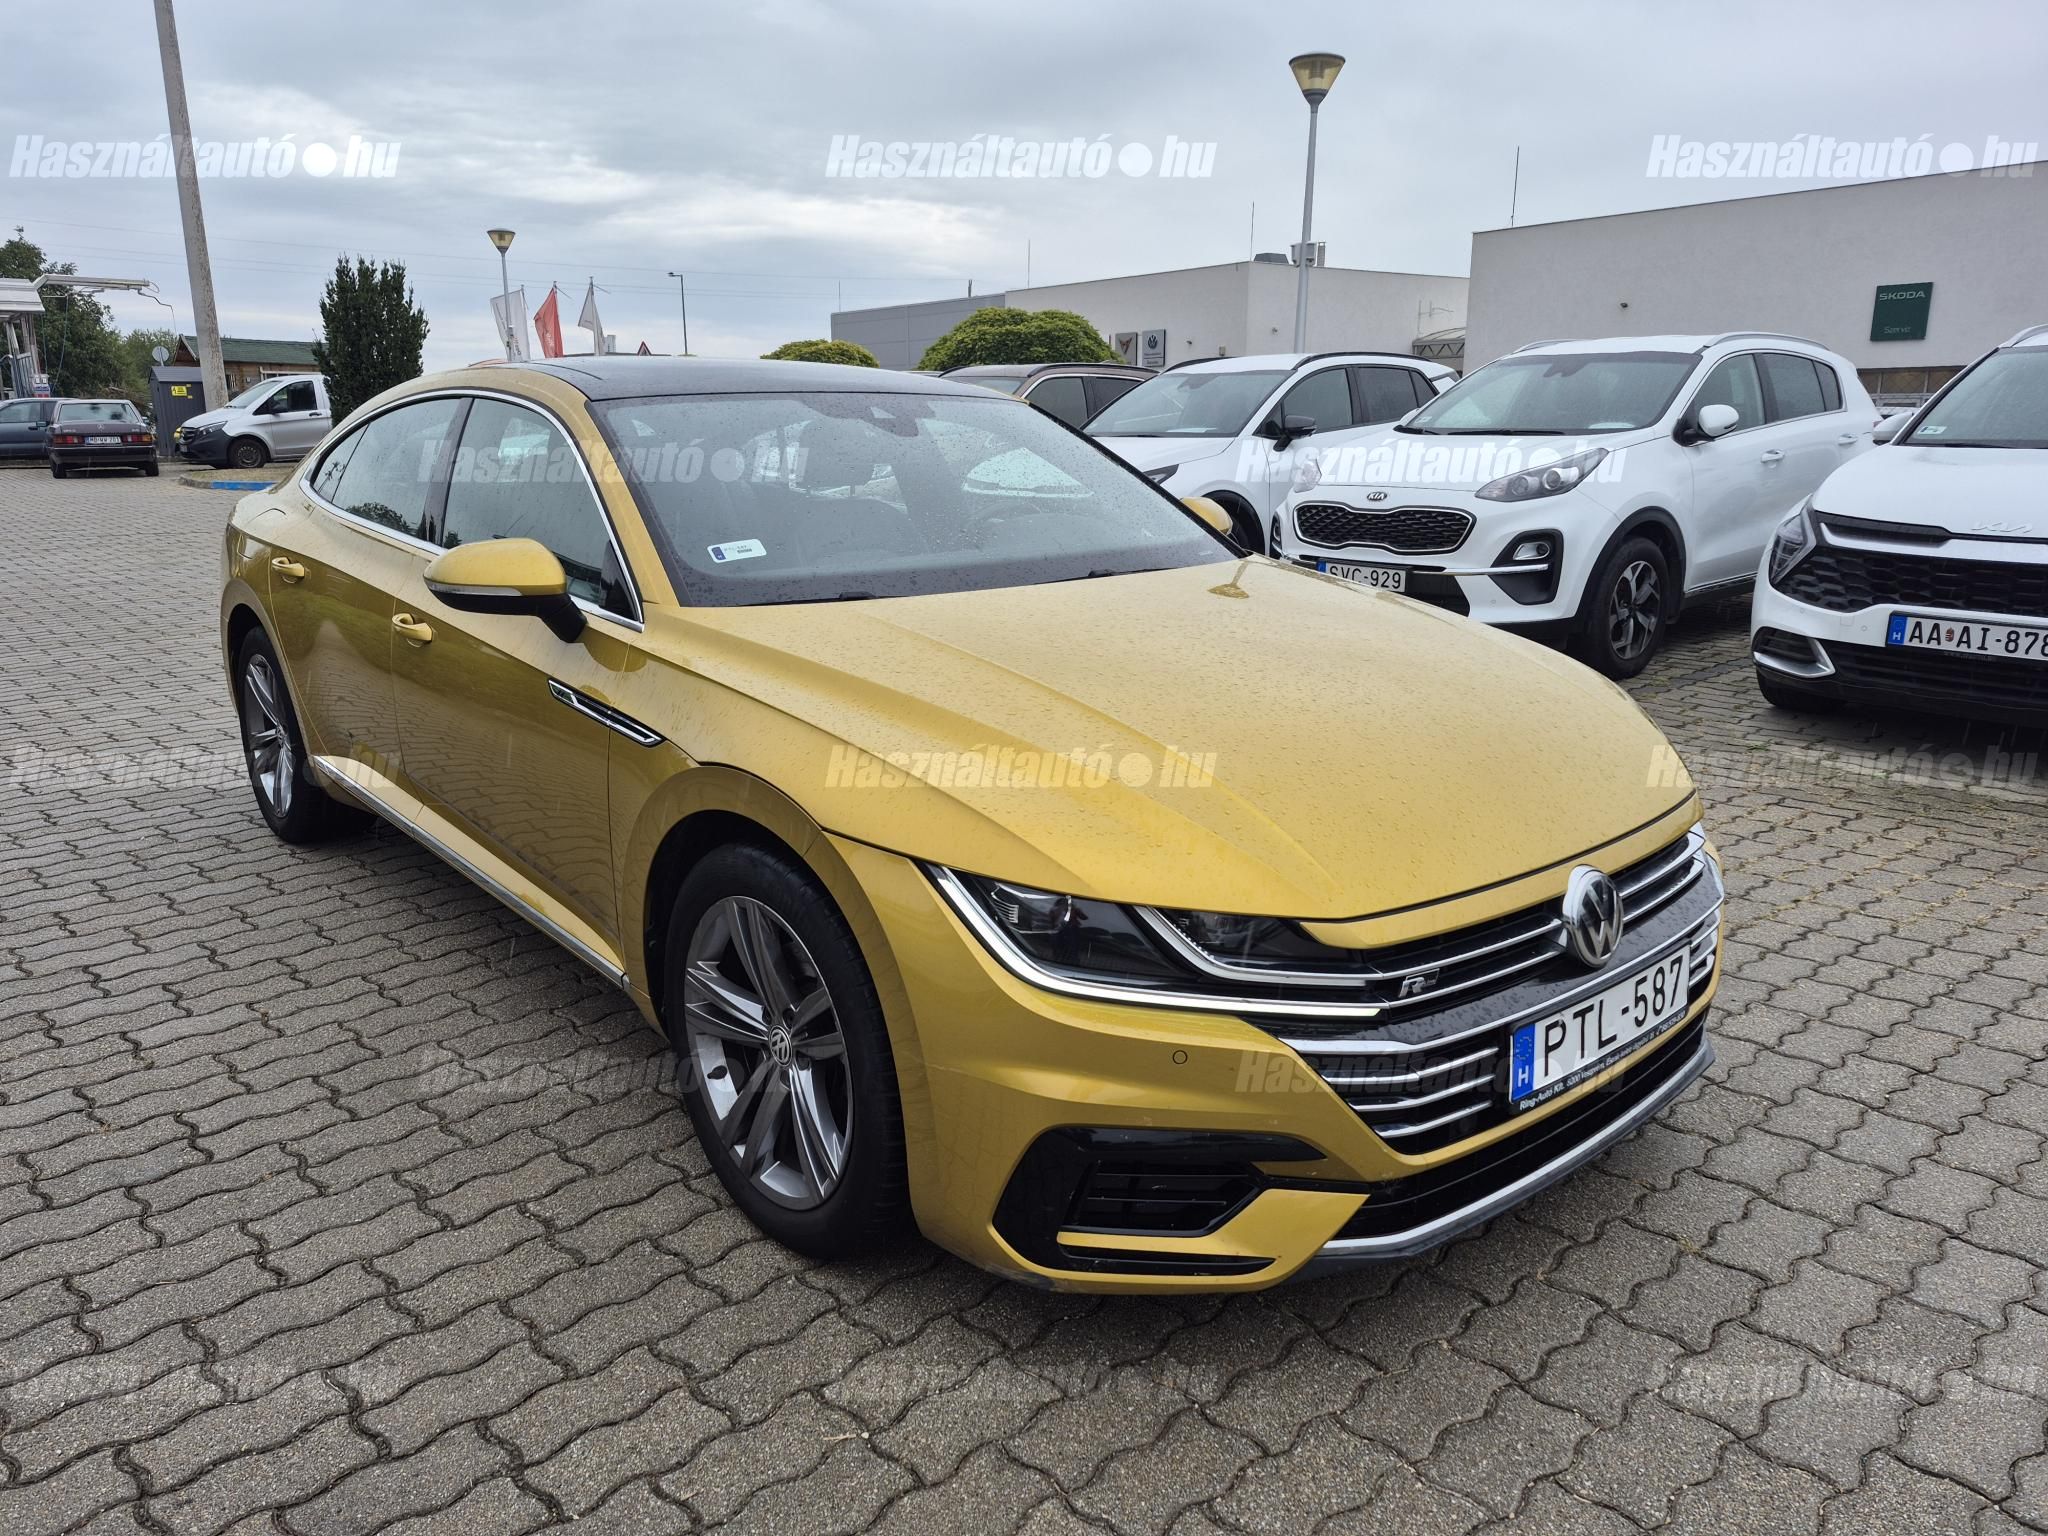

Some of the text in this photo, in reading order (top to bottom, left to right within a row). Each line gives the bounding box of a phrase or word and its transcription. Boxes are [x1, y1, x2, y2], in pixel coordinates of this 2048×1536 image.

[1368, 492, 1387, 501] KIA
[1908, 620, 1942, 646] AA
[1544, 955, 1683, 1078] PTL-587
[1517, 1064, 1530, 1088] H
